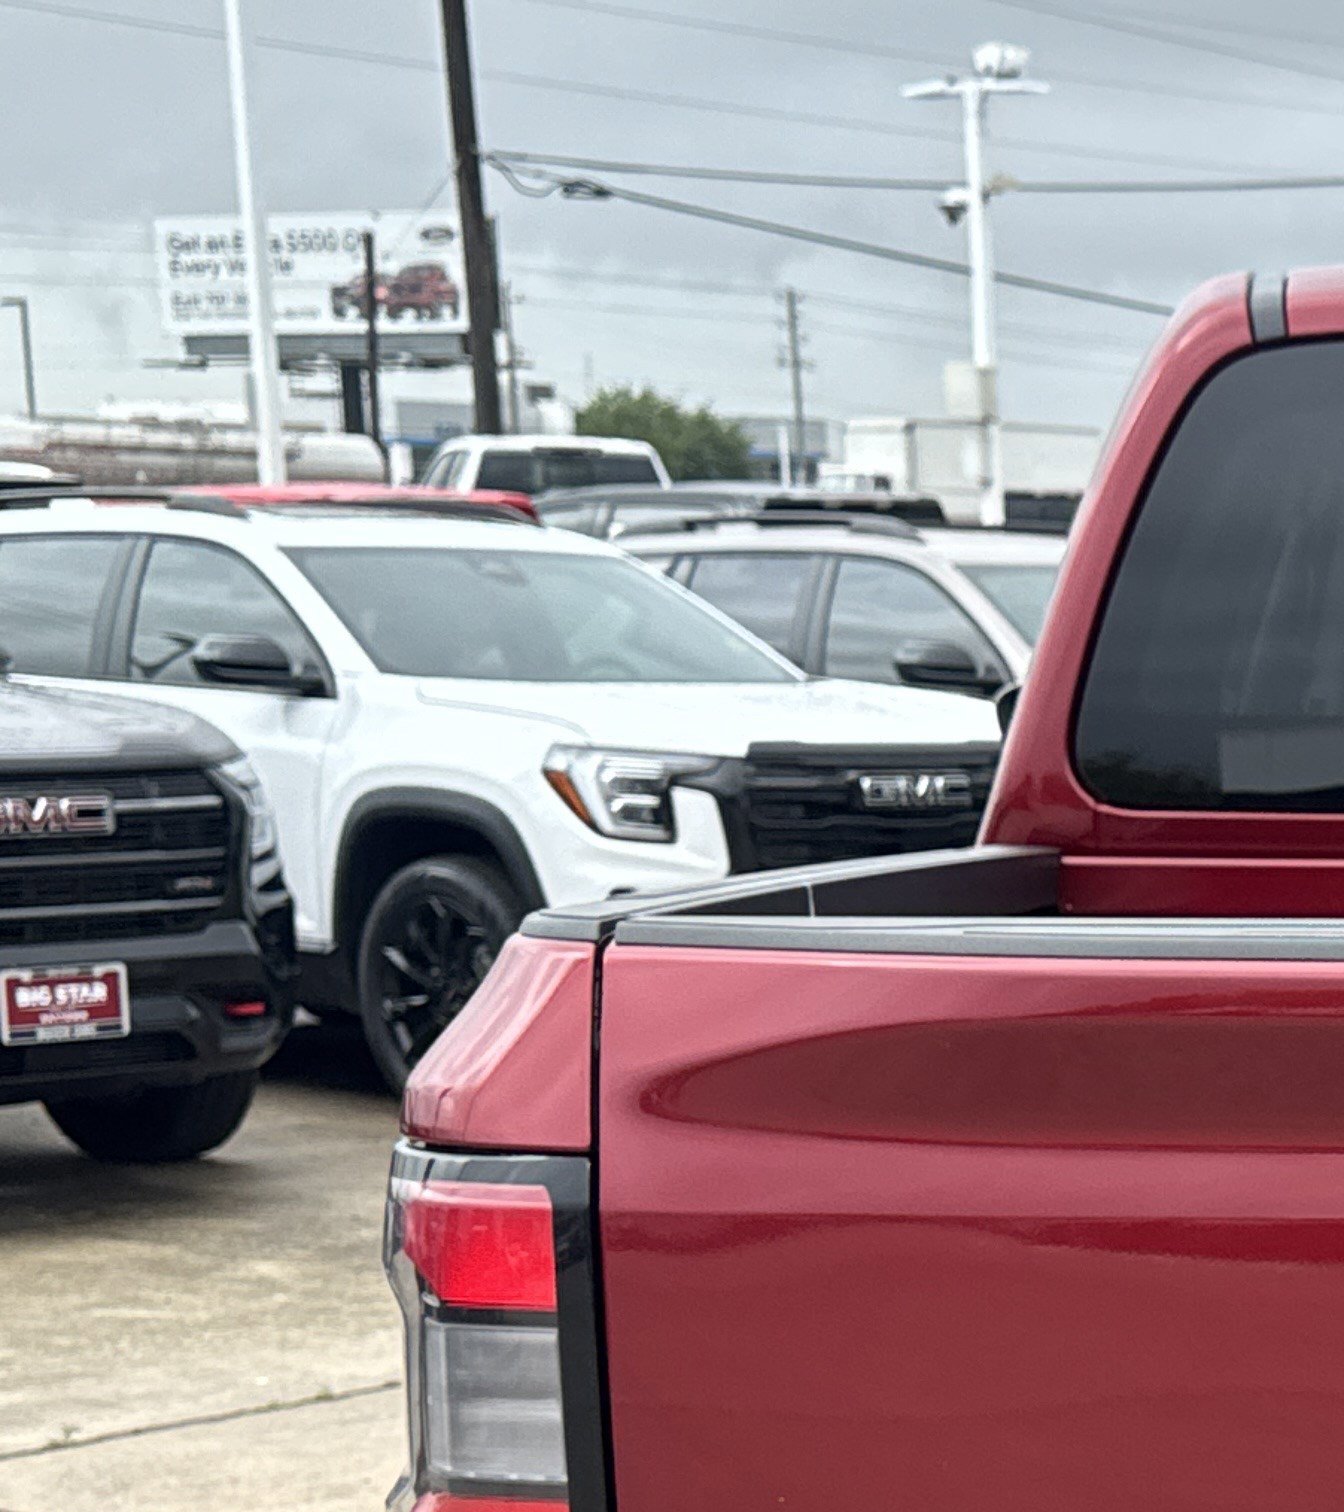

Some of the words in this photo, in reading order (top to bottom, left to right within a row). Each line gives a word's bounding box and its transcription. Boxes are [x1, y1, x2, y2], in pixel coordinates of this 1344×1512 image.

[859, 774, 971, 807] GMC
[0, 796, 110, 833] MC
[15, 985, 52, 1008] BIG
[54, 981, 107, 1005] STAR
